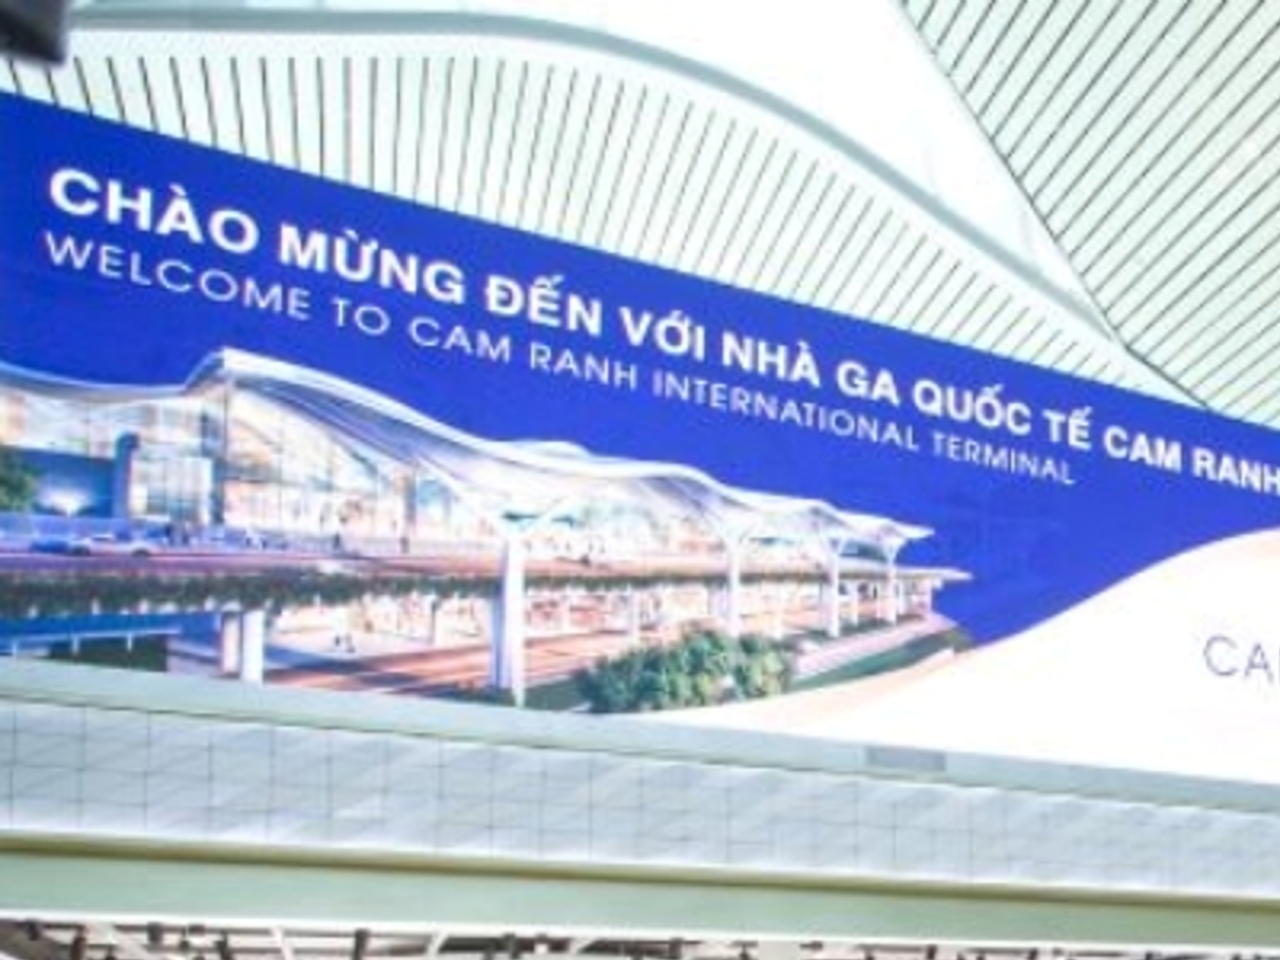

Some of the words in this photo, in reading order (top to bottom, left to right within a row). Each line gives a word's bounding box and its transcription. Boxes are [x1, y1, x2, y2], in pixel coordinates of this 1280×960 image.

[44, 231, 311, 321] WELCOME
[331, 298, 391, 335] TO
[410, 316, 511, 362] CAM
[530, 343, 638, 391] RANH
[653, 370, 921, 450] INTERNATIONAL
[932, 431, 1076, 485] TERMINAL
[49, 168, 259, 254] CHÀO
[278, 225, 466, 304] MỪNG
[485, 275, 601, 336] ĐẾN
[618, 308, 705, 361] VỚI
[721, 333, 821, 387] NHÀ
[835, 362, 899, 405] GA
[912, 383, 1032, 436] QUỐC
[1043, 405, 1093, 450] TẾ
[1104, 426, 1183, 474] CAM
